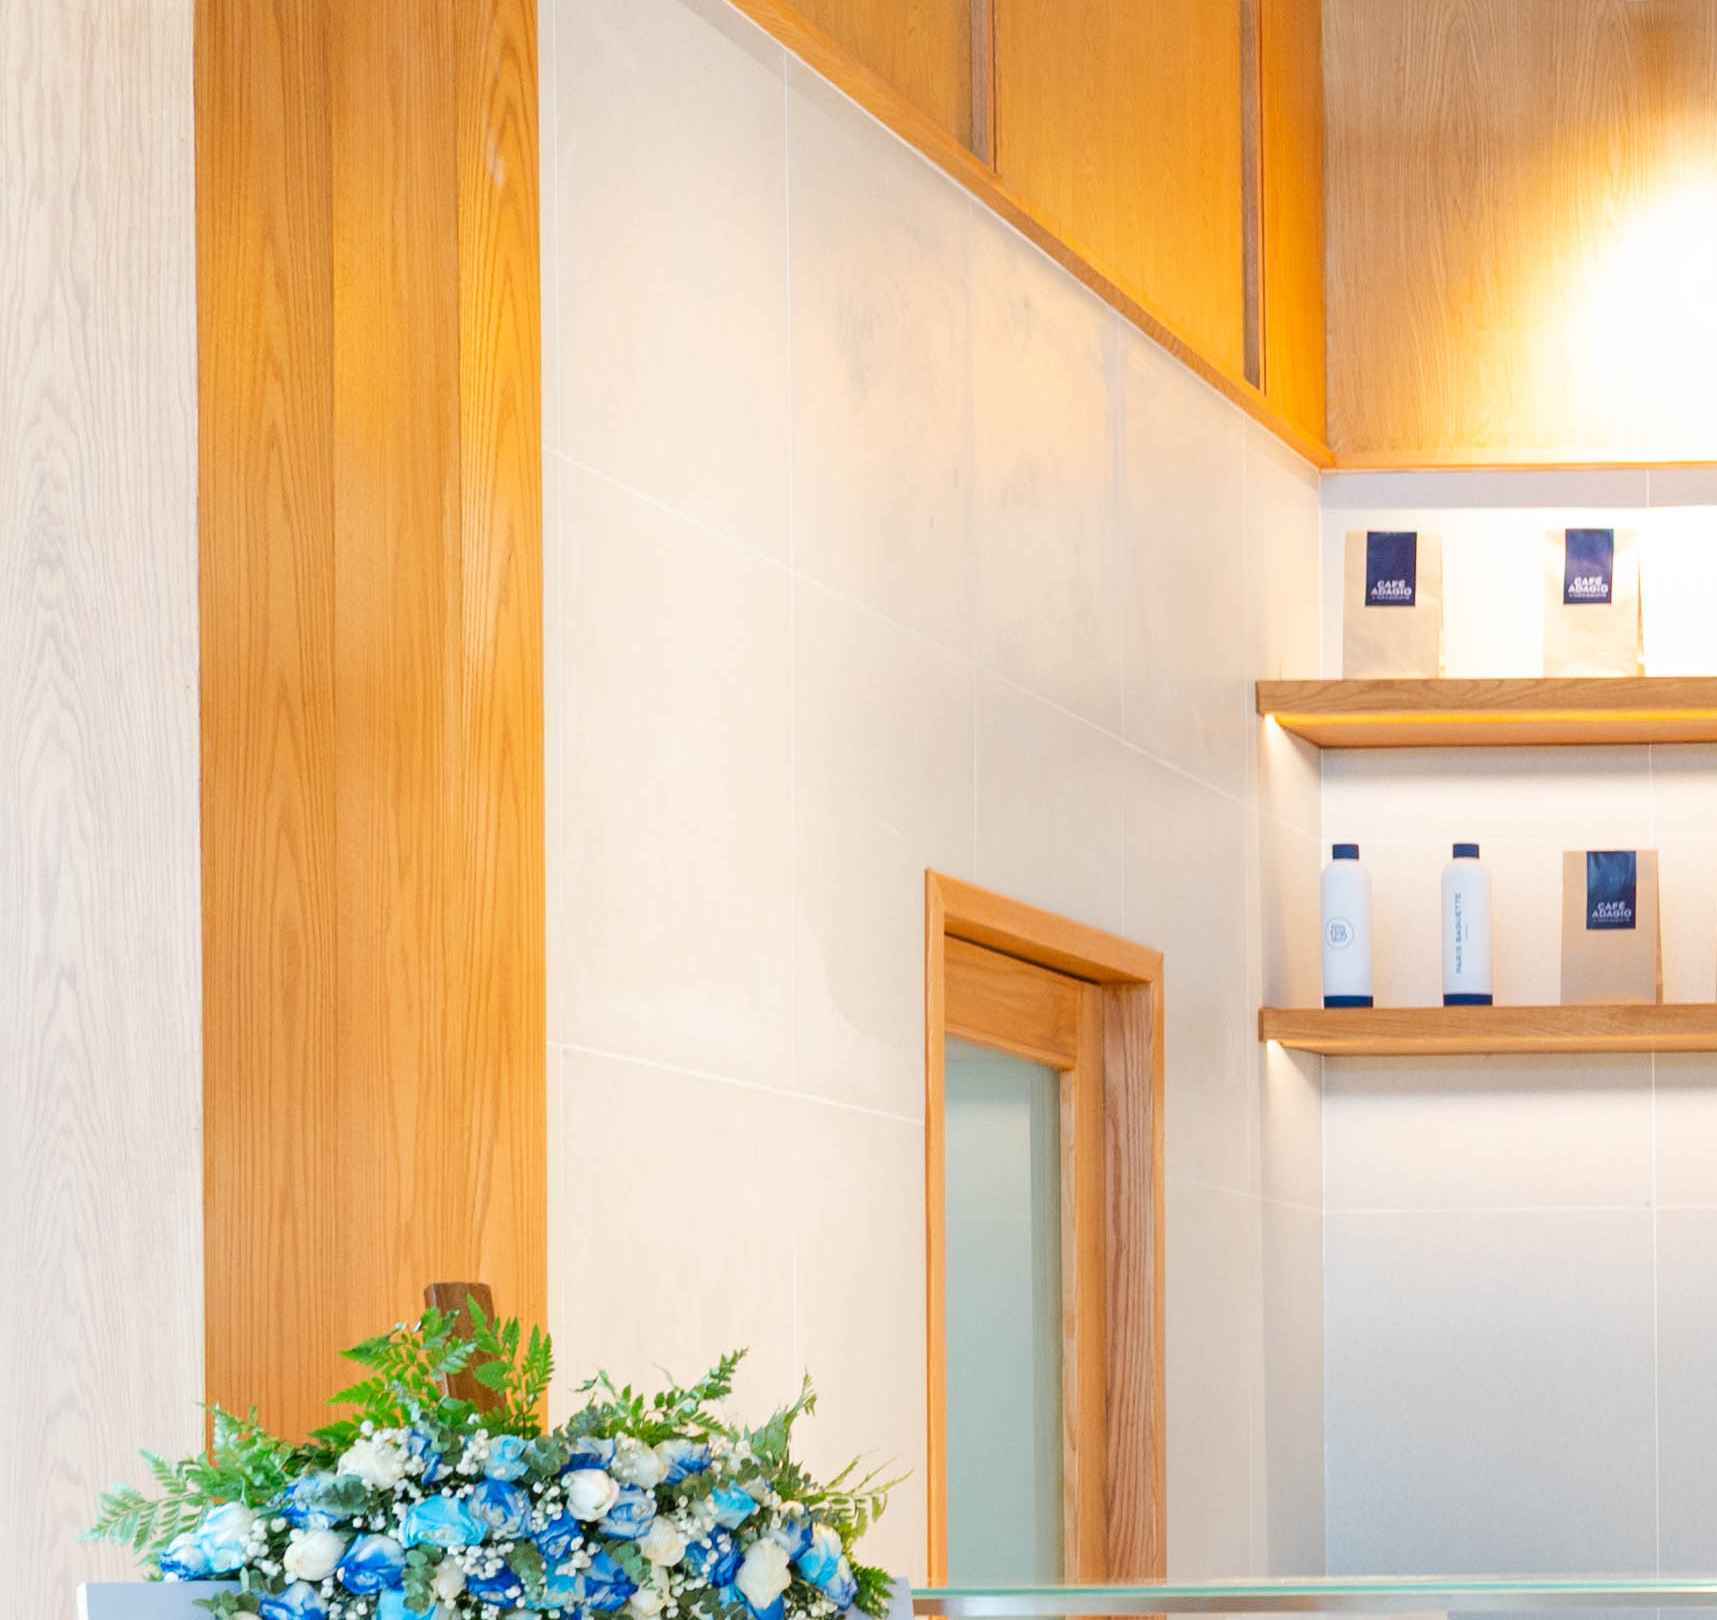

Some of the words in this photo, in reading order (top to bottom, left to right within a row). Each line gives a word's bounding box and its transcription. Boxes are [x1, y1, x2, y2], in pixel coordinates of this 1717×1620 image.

[1377, 580, 1405, 589] CAFÉ
[1574, 576, 1602, 586] CAFÉ
[1371, 587, 1412, 596] ADAGIO
[1568, 584, 1608, 593] ADAGIO
[1597, 901, 1626, 911] CAFÉ
[1591, 909, 1632, 918] ADAGIO
